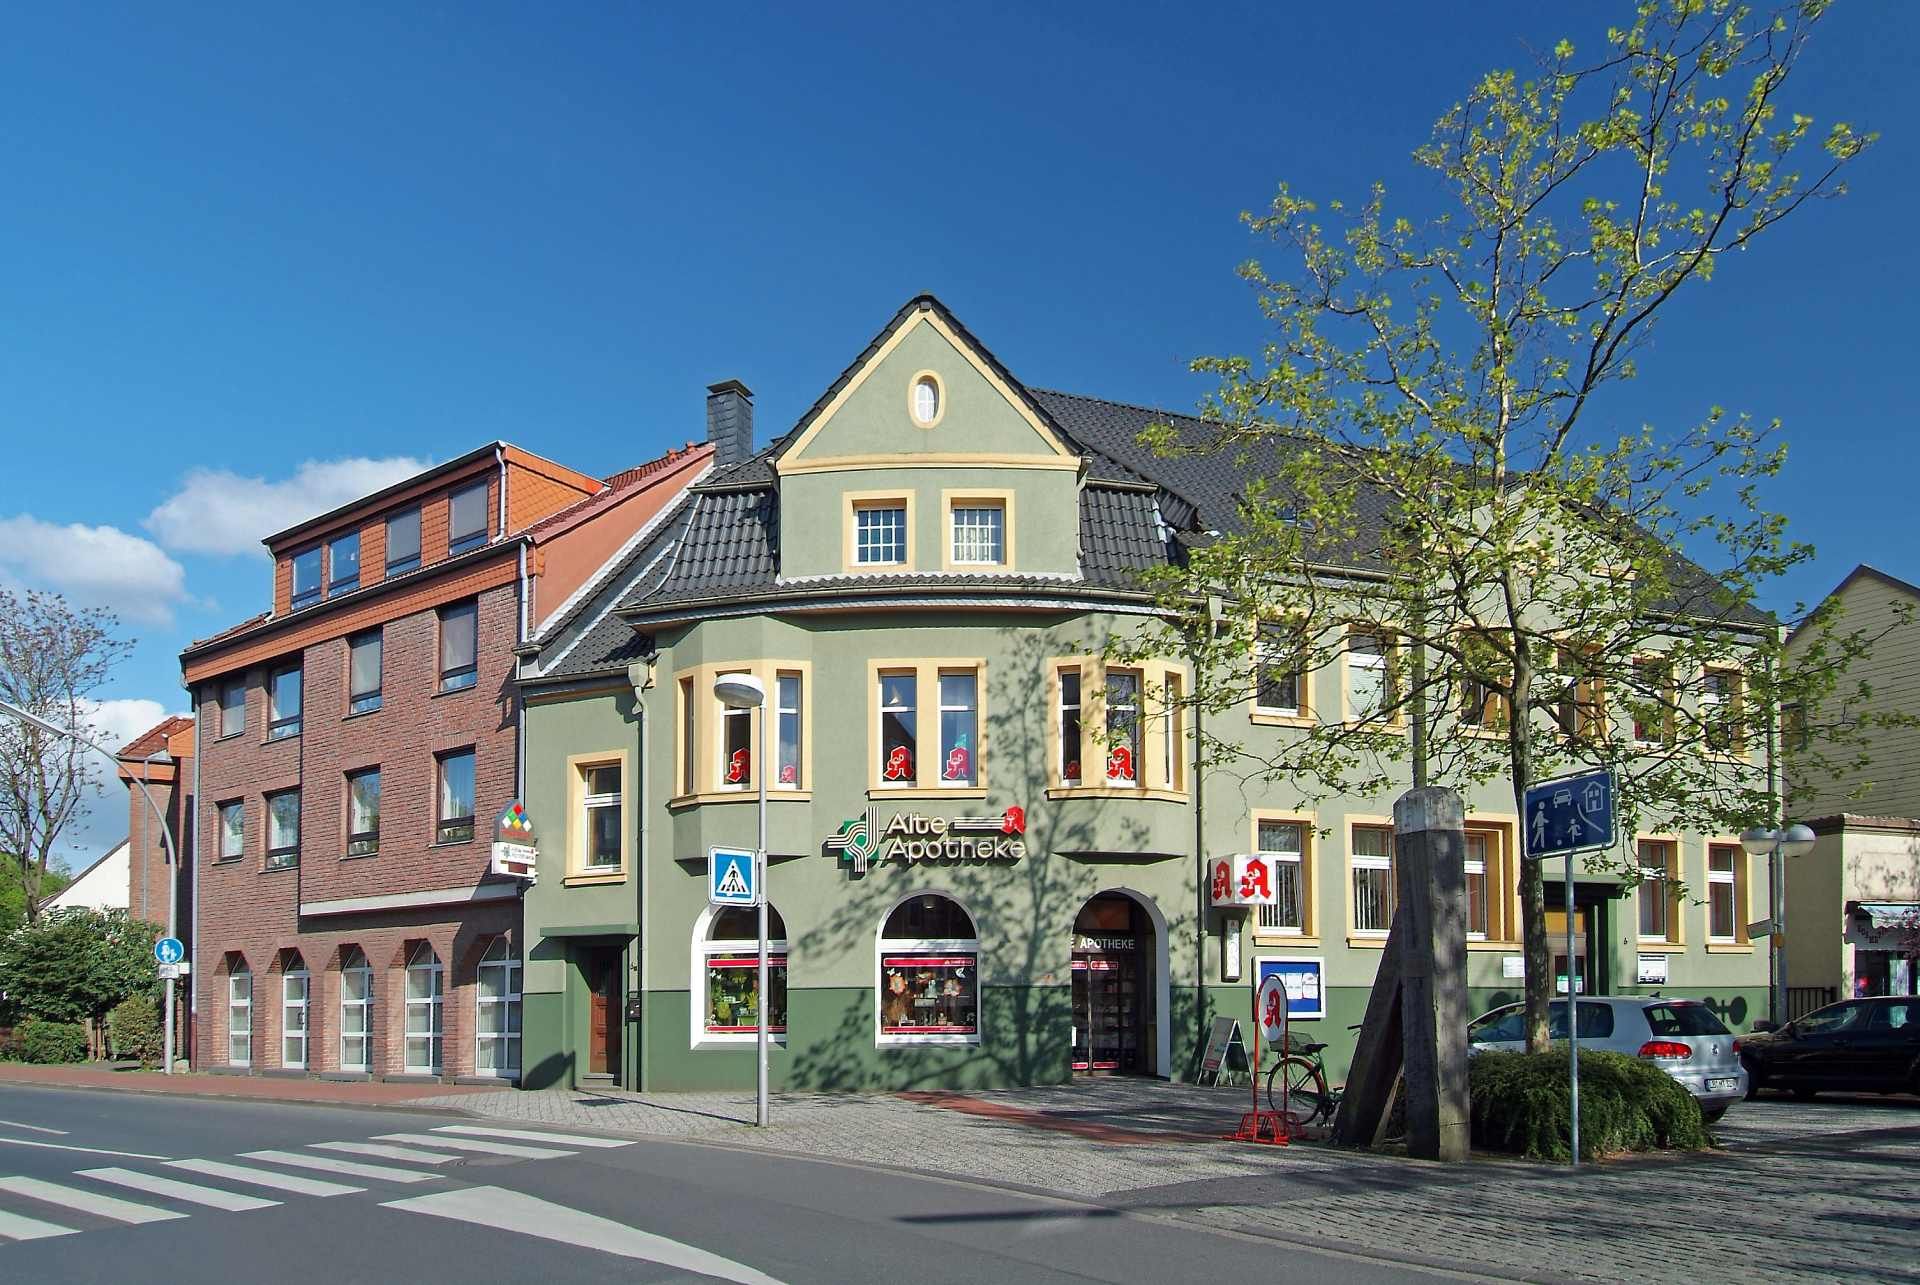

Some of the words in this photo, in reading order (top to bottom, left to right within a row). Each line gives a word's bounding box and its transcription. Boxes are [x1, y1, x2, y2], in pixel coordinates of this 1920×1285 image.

[887, 812, 947, 835] Alte
[887, 836, 1026, 864] Apotheke
[1213, 861, 1233, 900] A
[1240, 859, 1272, 899] A
[1080, 937, 1135, 950] APOTHEKE
[1264, 988, 1282, 1029] A
